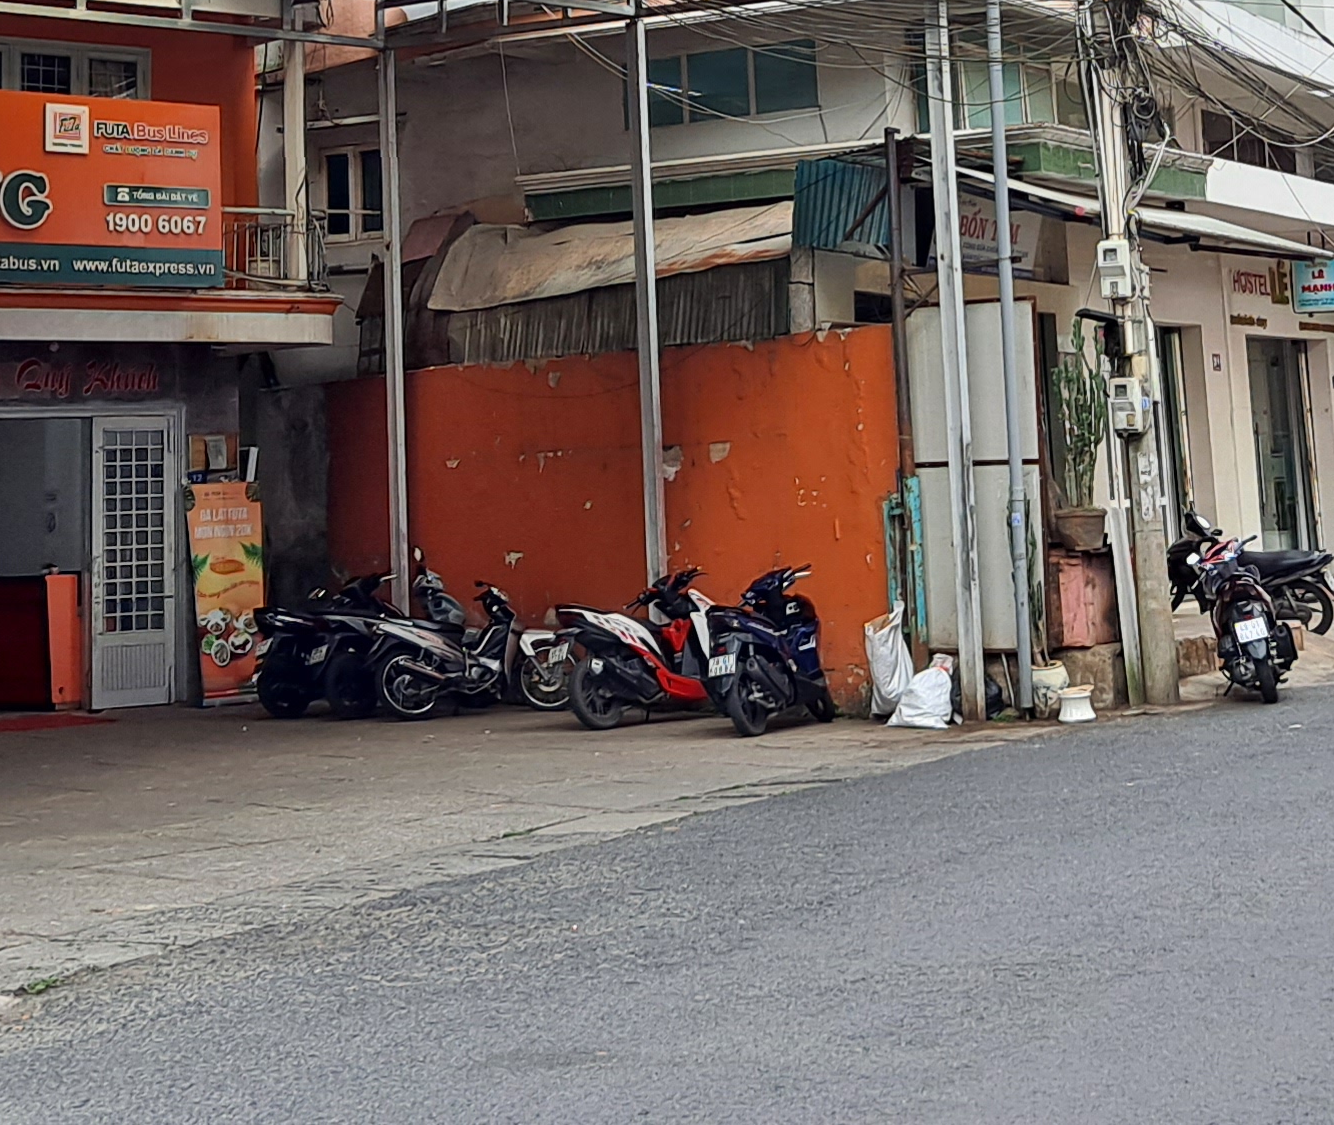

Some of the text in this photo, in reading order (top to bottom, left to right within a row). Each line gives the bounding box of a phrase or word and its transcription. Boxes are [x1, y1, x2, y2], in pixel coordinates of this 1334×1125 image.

[94, 121, 209, 144] FUTA Bus Lines
[106, 212, 207, 234] 1900 6067
[72, 258, 215, 276] www.futaexpress.vn
[1233, 269, 1271, 296] HOSTEL
